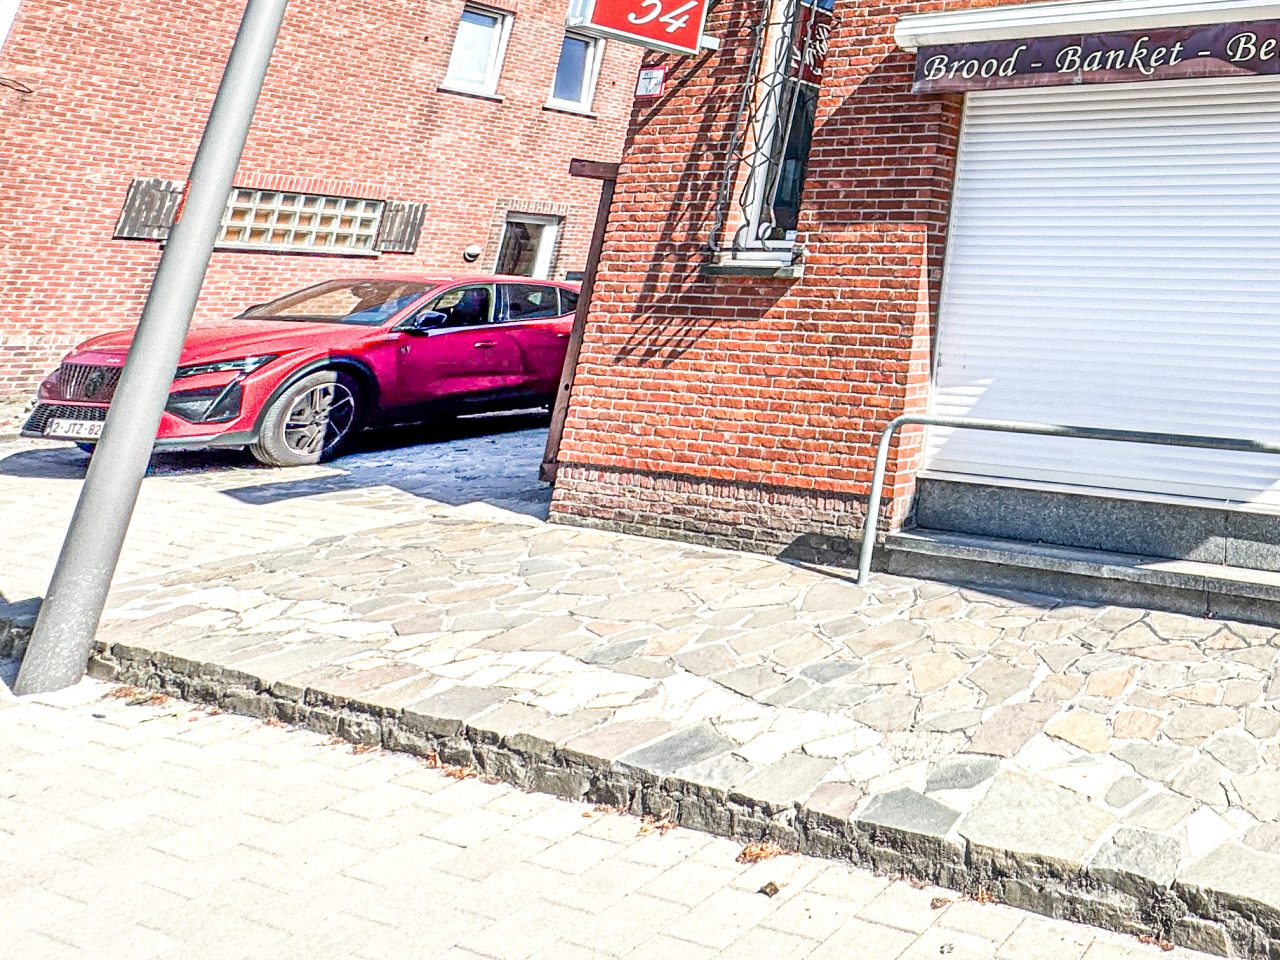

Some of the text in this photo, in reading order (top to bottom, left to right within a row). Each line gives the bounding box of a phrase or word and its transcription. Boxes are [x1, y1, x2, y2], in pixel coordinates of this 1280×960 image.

[923, 44, 1027, 81] Brood
[1055, 36, 1184, 76] Banket
[52, 421, 102, 436] 2-JTZ-82
